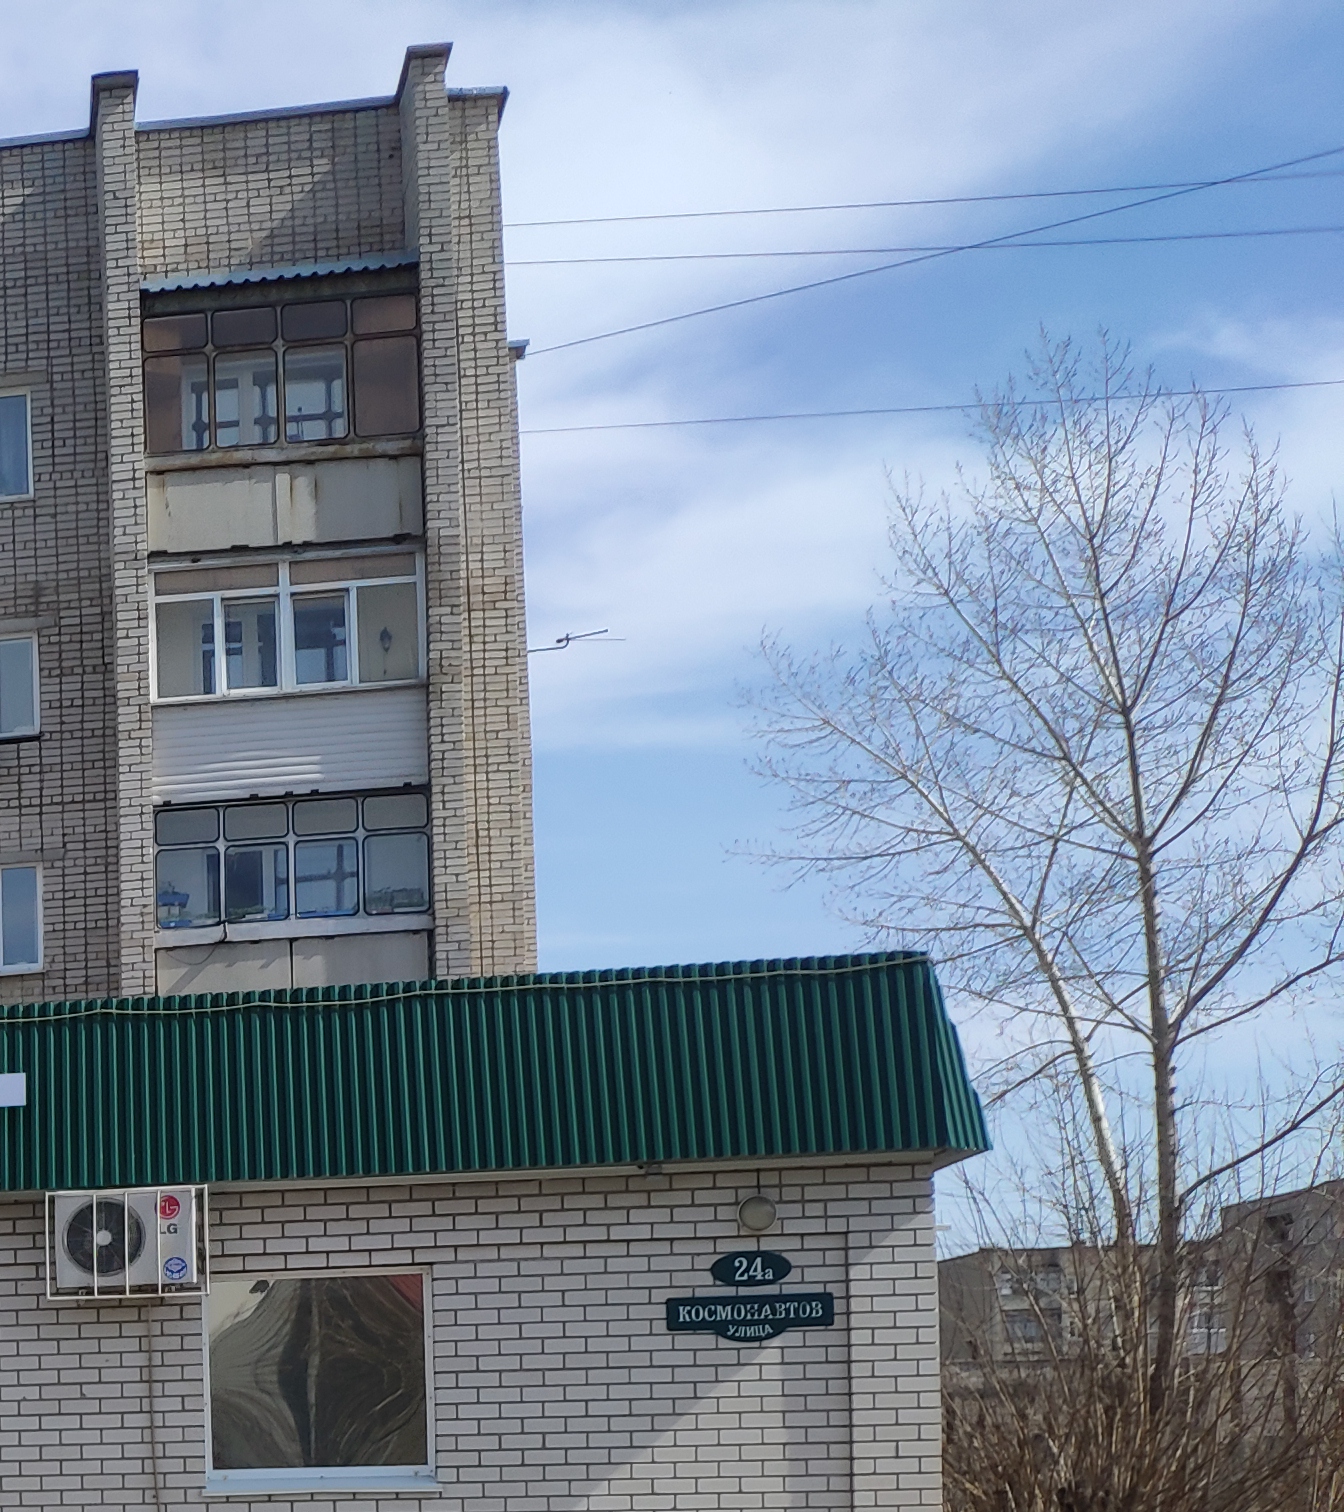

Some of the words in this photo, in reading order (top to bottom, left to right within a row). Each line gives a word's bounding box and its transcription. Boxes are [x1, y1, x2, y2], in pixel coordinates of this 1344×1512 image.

[159, 1222, 178, 1235] LG
[677, 1301, 824, 1323] КОСМОНАВТОВ
[726, 1324, 774, 1338] УЛИЦА
